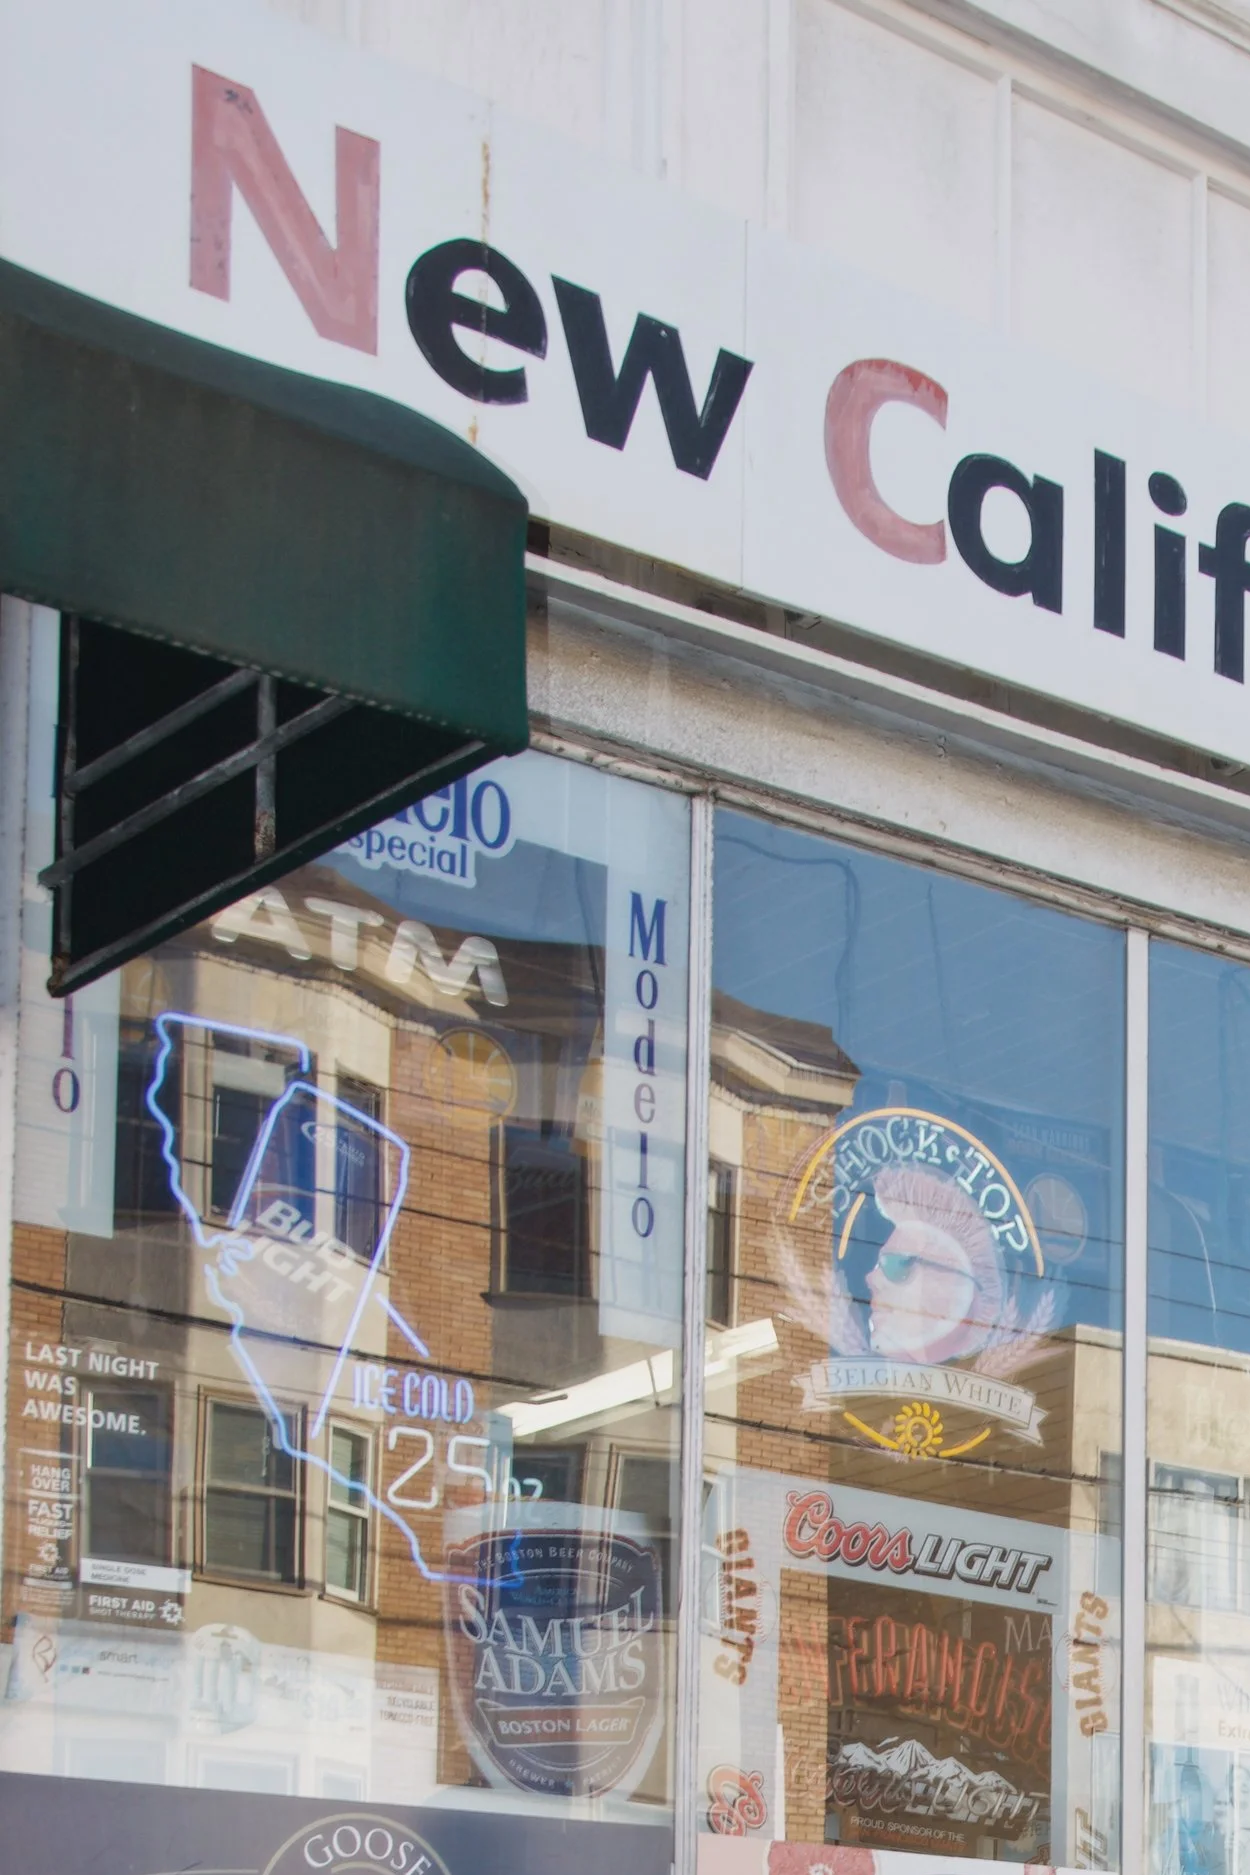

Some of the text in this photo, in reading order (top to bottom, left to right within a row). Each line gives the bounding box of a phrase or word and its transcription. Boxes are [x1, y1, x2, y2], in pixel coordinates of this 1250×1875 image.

[190, 62, 753, 481] New
[210, 885, 508, 1007] ATM
[628, 891, 668, 1239] Modelo
[798, 1116, 944, 1224] SHOCK
[957, 1147, 1030, 1252] TOP
[24, 1340, 159, 1380] LAST NIGHT
[24, 1369, 76, 1396] WAS
[353, 1364, 398, 1414] ICE
[823, 1365, 1022, 1416] BELGIAN WHITE
[21, 1398, 146, 1435] AWESOME.
[30, 1464, 71, 1479] HANG
[32, 1477, 70, 1491] OVER
[387, 1426, 492, 1510] 25
[27, 1499, 74, 1520] FAST
[549, 1547, 584, 1560] BEER
[783, 1490, 1053, 1592] Coors LIGHT
[90, 1594, 154, 1612] FIRST AID
[459, 1583, 656, 1660] SAMUEL
[474, 1639, 647, 1697] ADAMS
[1072, 1590, 1108, 1738] GIANTS
[498, 1717, 631, 1735] BOSTON LAGER
[850, 1816, 885, 1830] PROUD
[887, 1821, 932, 1838] SPONSOR
[934, 1830, 946, 1839] OF
[948, 1832, 965, 1842] THE
